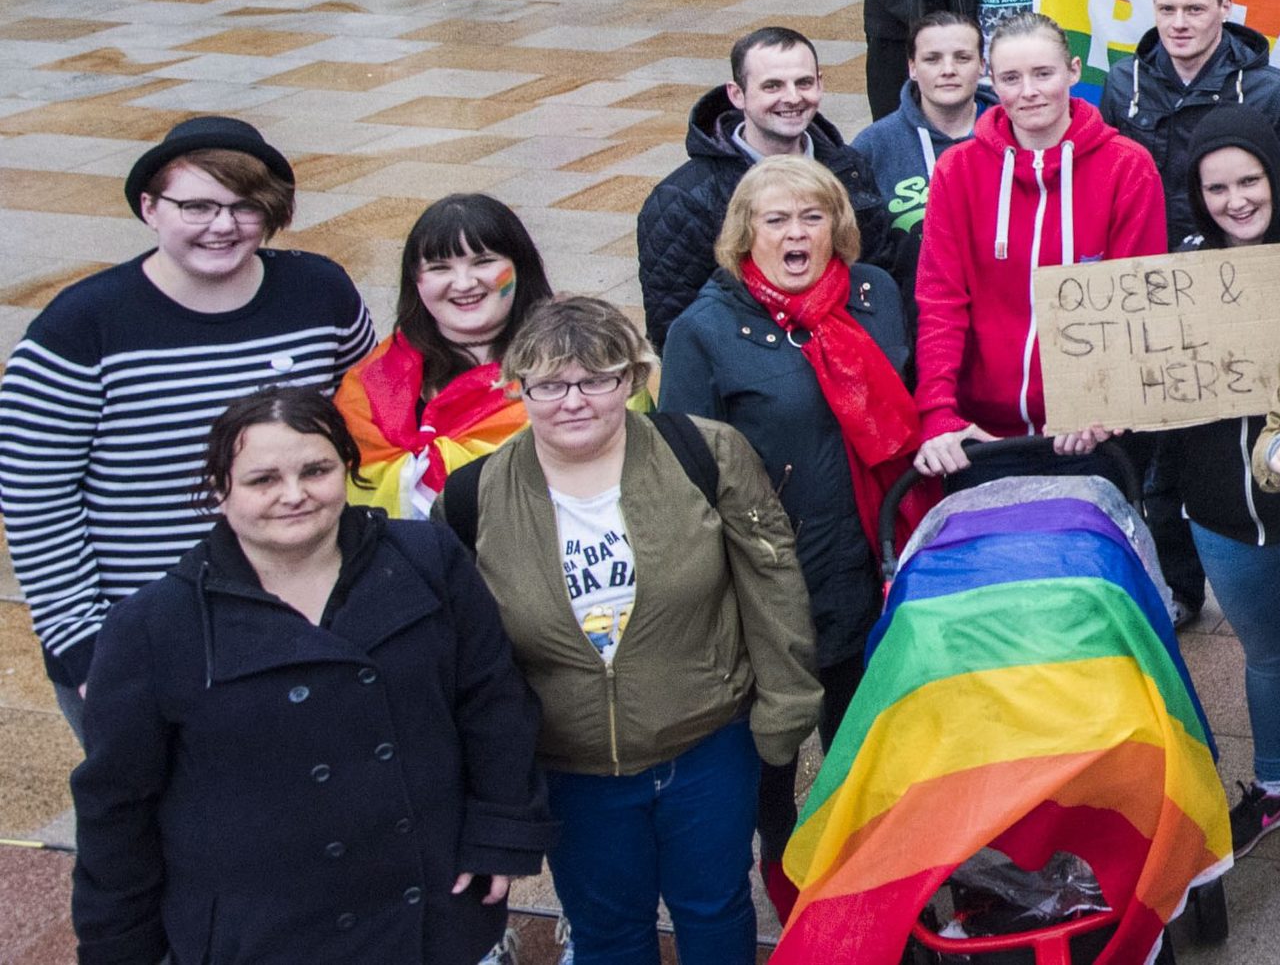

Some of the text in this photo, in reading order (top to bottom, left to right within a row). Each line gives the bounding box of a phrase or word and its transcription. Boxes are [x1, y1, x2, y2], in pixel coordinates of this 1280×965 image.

[1058, 261, 1243, 314] QUEER &
[1059, 315, 1209, 357] STILL
[1139, 359, 1255, 405] HERE
[563, 559, 579, 574] BA
[565, 530, 621, 567] BA BA BA
[565, 567, 603, 601] BA
